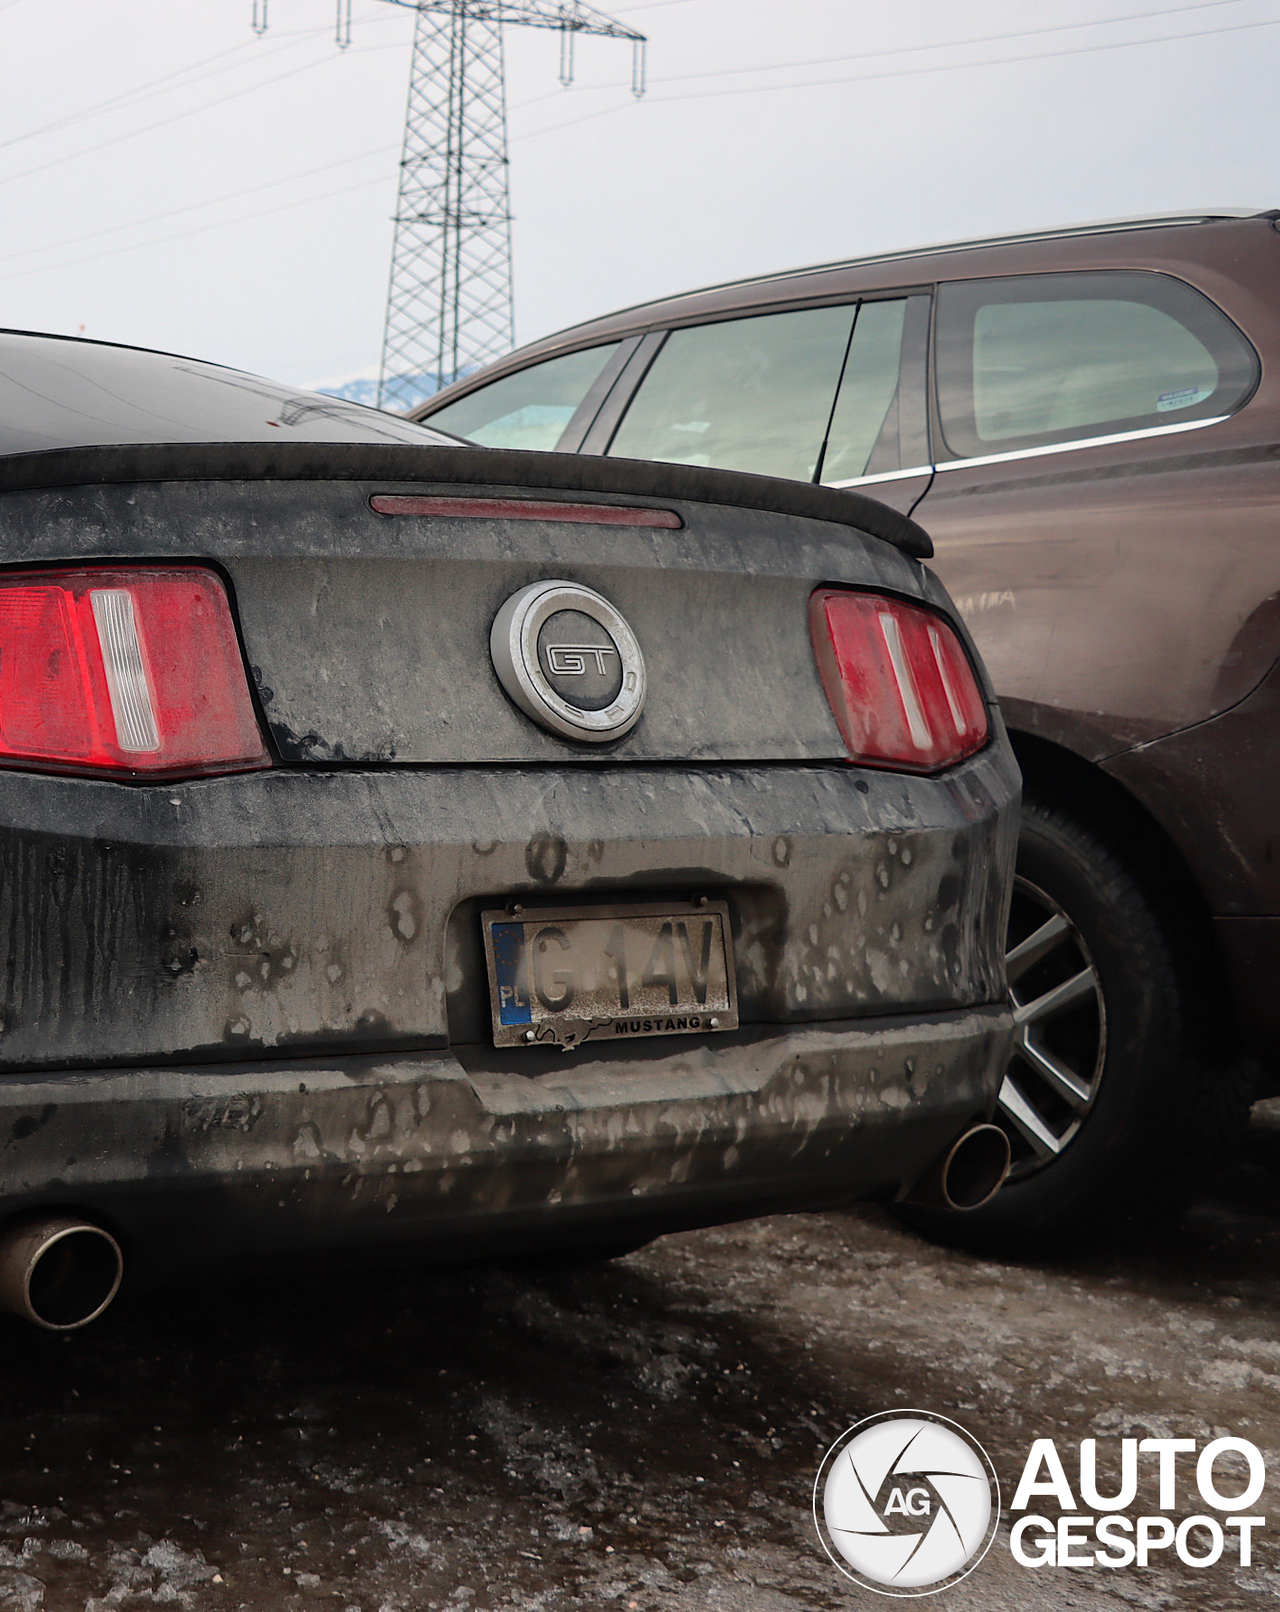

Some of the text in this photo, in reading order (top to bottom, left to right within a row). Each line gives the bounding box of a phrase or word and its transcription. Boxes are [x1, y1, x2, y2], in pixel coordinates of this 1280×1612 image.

[546, 644, 615, 676] GT
[500, 985, 526, 1008] PL
[615, 1016, 701, 1034] MUSTANG
